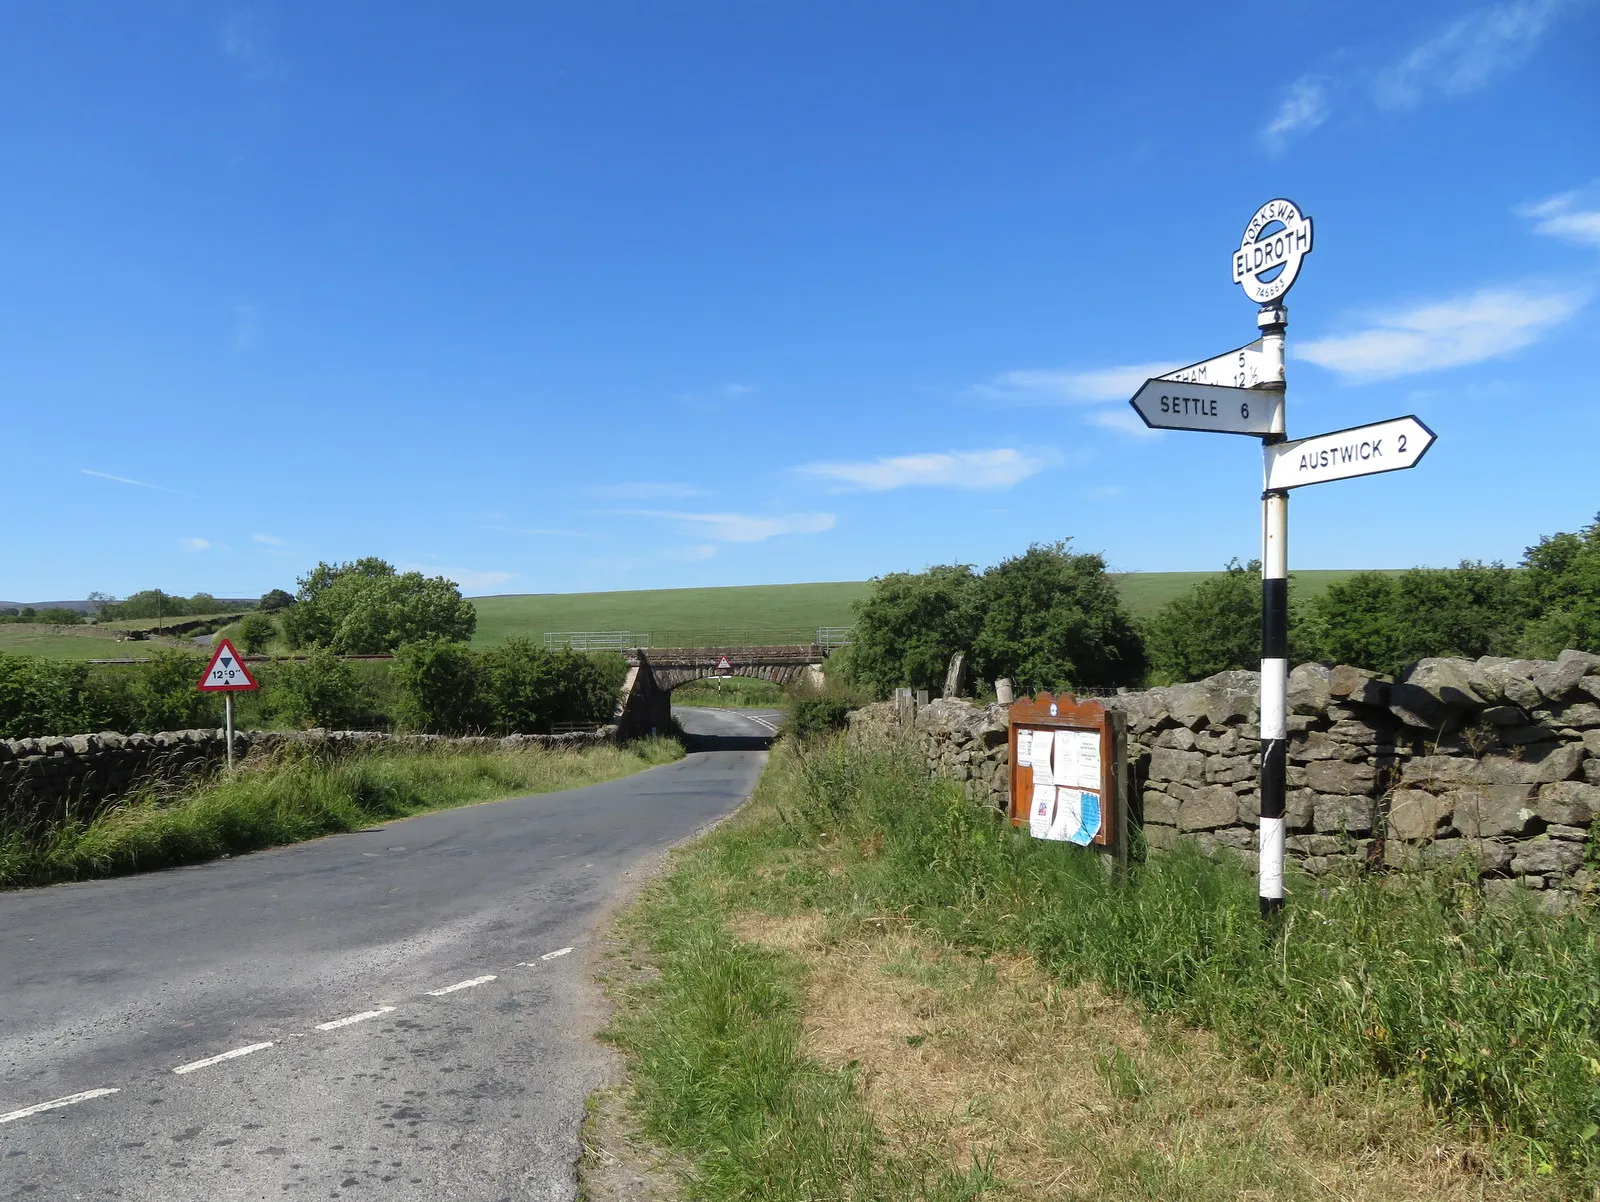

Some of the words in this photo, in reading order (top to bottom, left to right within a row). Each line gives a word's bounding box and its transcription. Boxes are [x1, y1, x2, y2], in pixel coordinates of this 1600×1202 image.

[1236, 225, 1307, 276] ELDROTH
[1238, 352, 1246, 368] 5
[1160, 395, 1218, 416] SETTLE
[1241, 403, 1250, 419] 6
[1299, 438, 1383, 471] AUSTWICK
[1397, 434, 1407, 453] 2
